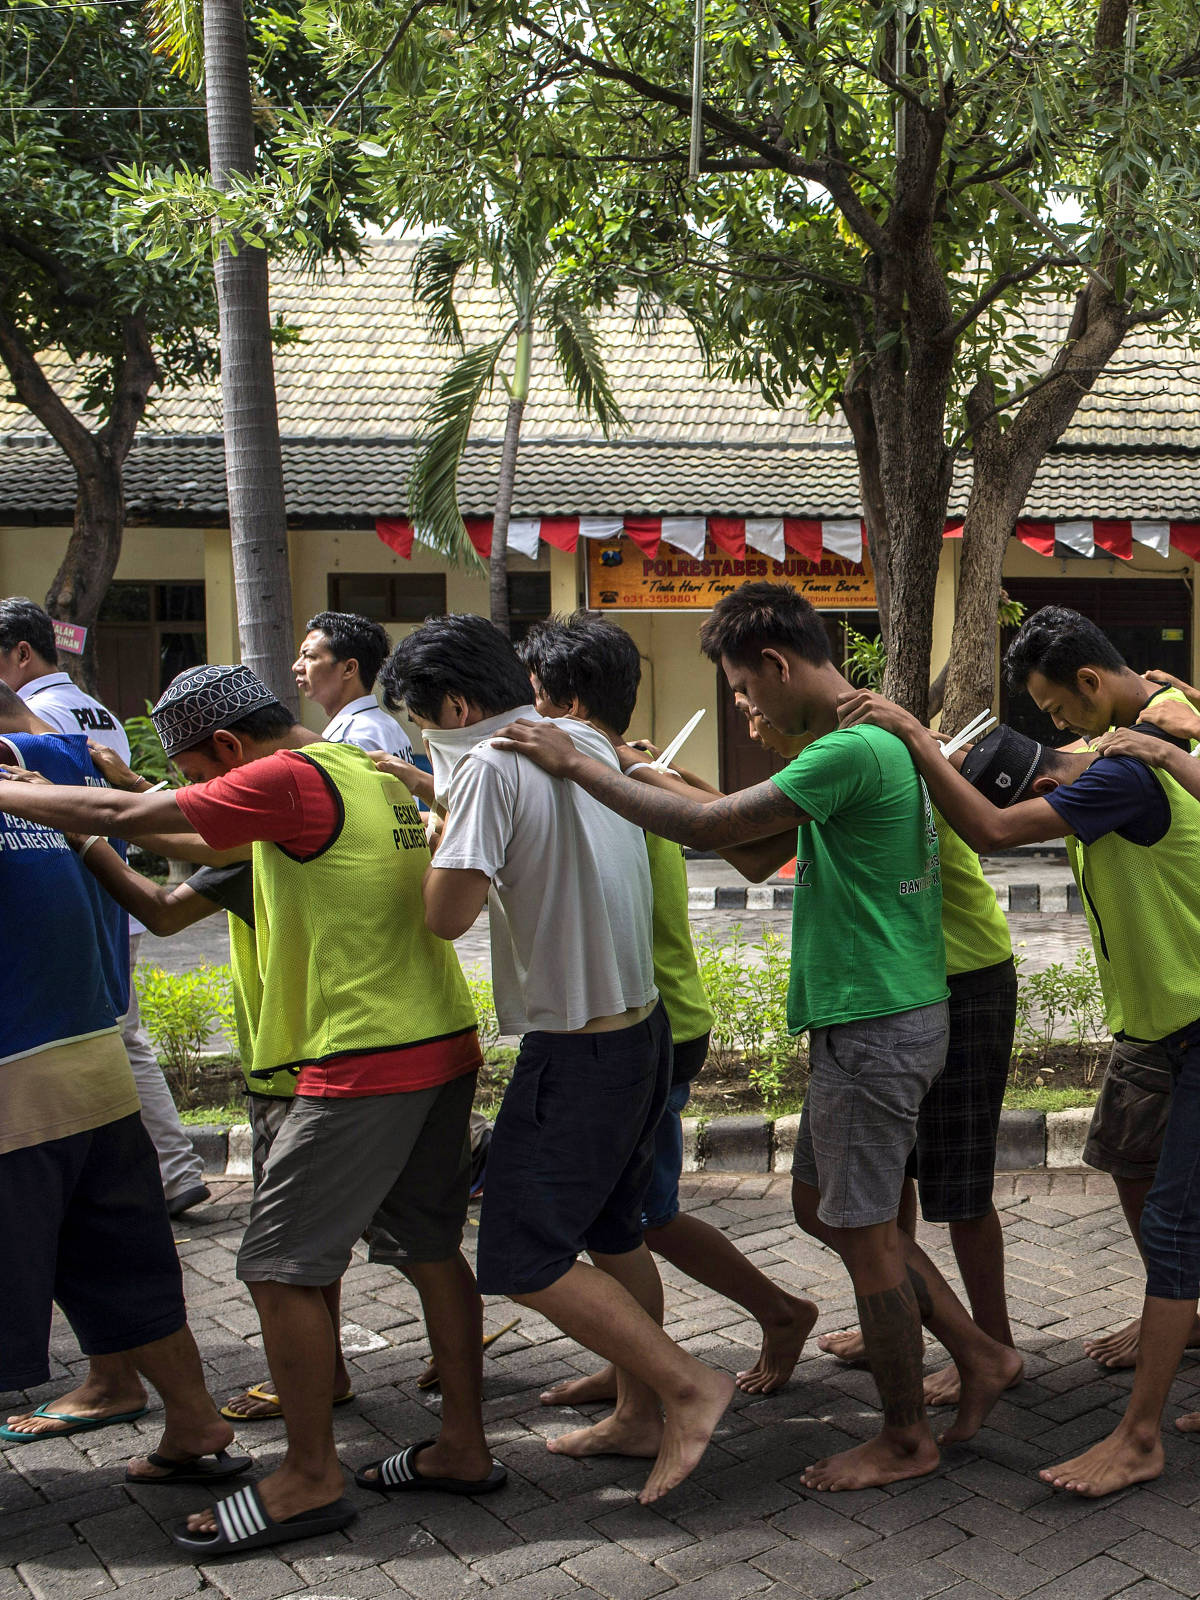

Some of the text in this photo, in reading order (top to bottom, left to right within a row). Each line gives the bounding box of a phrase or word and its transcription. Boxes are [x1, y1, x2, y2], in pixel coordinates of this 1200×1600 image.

[643, 559, 866, 577] POLRESTABES SURABAYA
[679, 580, 704, 593] Hari
[623, 594, 697, 604] 031-3559801
[53, 624, 75, 637] ALAH
